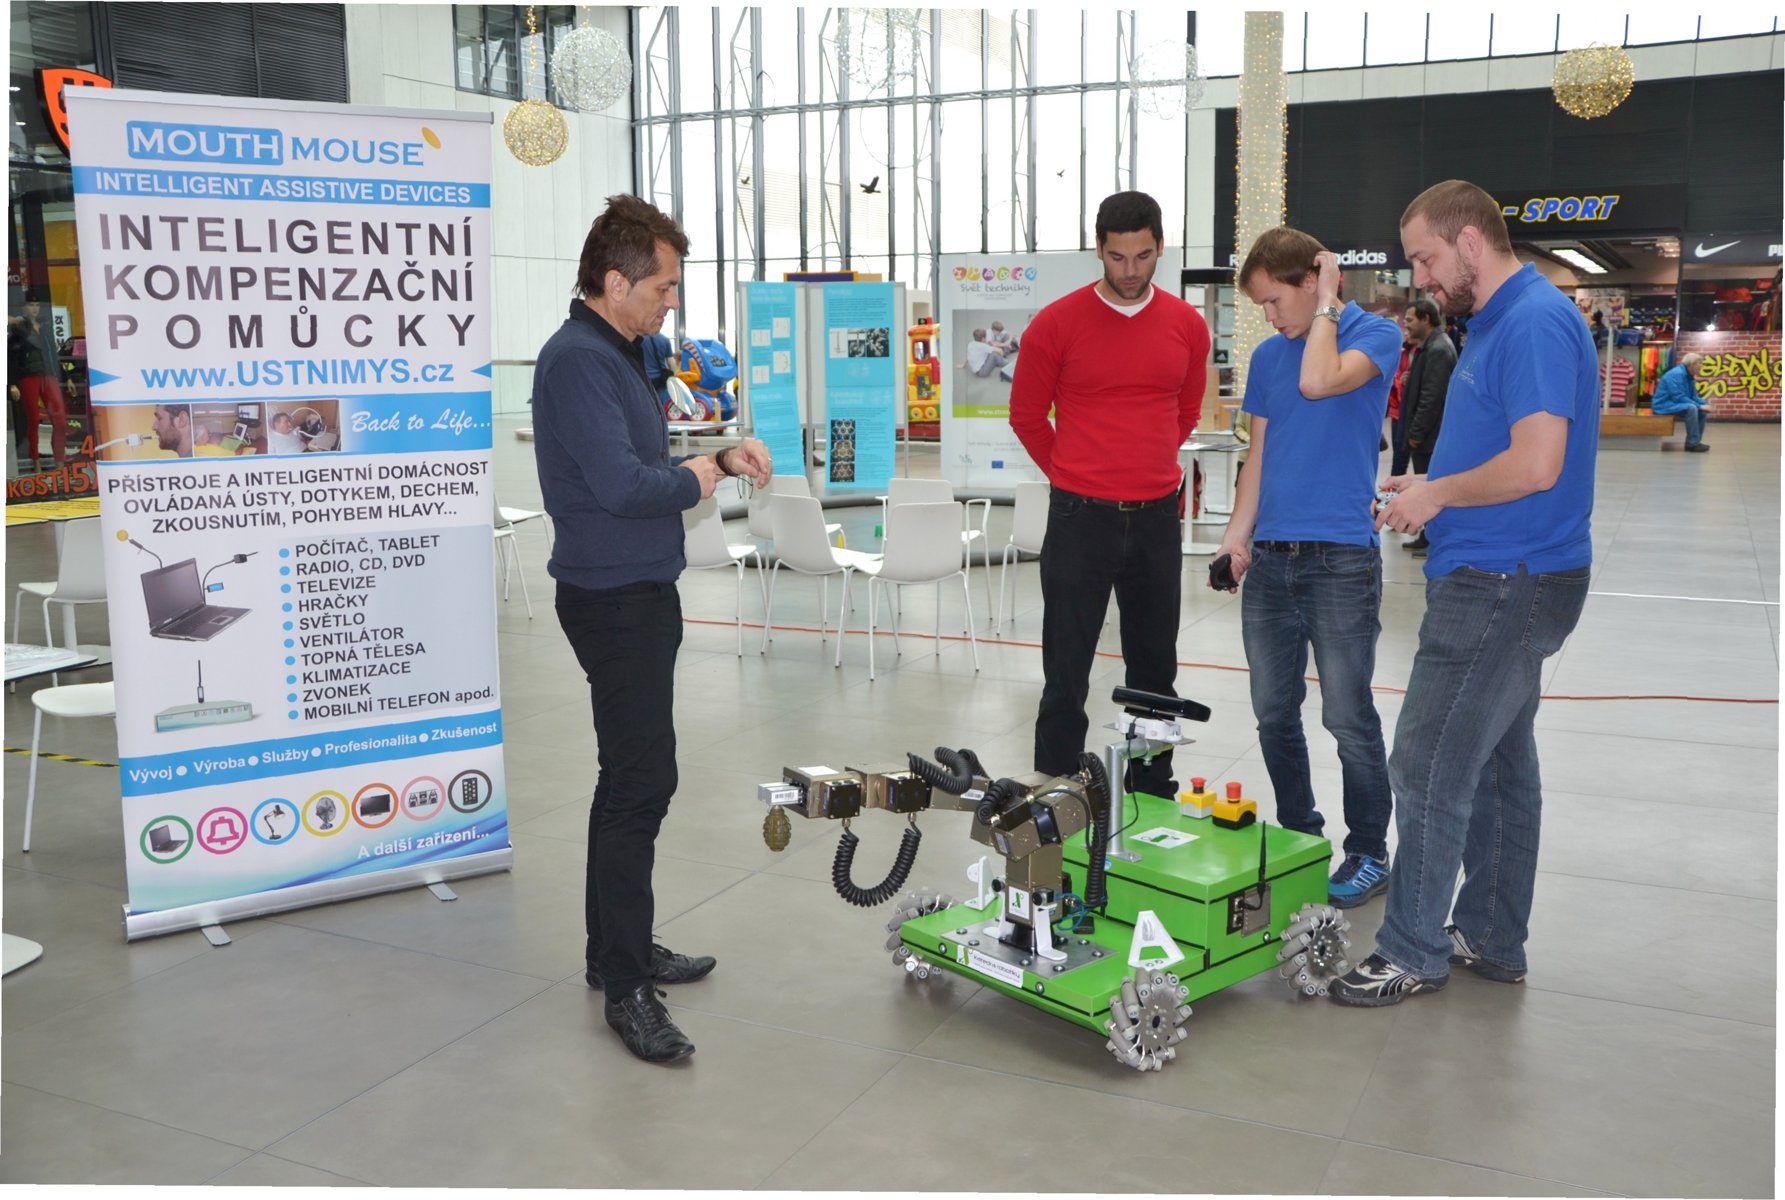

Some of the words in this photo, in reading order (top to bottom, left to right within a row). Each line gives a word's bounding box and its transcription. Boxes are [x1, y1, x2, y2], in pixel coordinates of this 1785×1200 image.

[132, 128, 280, 160] MOUTH
[292, 137, 424, 166] MOUSE
[96, 172, 255, 196] INTELLIGENT
[259, 179, 373, 199] ASSISTIVE
[380, 183, 470, 203] DEVICES
[1520, 195, 1620, 223] SPORT
[99, 213, 472, 257] INTELIGENTNÍ
[1336, 250, 1387, 265] adidas
[104, 260, 473, 301] KOMPENZAČNÍ
[960, 283, 980, 292] Svět
[985, 283, 1031, 296] techniky
[108, 305, 475, 350] POMŮCKY
[141, 358, 454, 389] www.USTNIMYS.cz
[351, 411, 400, 434] Back
[407, 413, 424, 430] to
[430, 409, 491, 435] Life...
[109, 472, 221, 493] PŘÍSTROJE
[226, 473, 240, 488] A
[245, 463, 372, 487] INTELIGENTNÍ
[379, 459, 488, 480] DOMÁCNOST
[124, 490, 235, 514] OVLÁDANÁ
[242, 487, 295, 508] ÚSTY,
[301, 484, 395, 503] DOTYKEM,
[400, 480, 479, 499] DECHEM,
[152, 508, 286, 534] ZKOUSNUTÍM,
[292, 504, 382, 525] POHYBEM
[388, 501, 457, 519] HLAVY...
[295, 537, 373, 557] POČÍTAČ,
[378, 535, 440, 551] TABLET
[296, 559, 354, 576] RADIO,
[359, 557, 387, 571] CD,
[393, 554, 425, 569] DVD
[297, 576, 376, 594] TELEVIZE
[298, 594, 368, 612] HRAČKY
[299, 612, 365, 631] SVĚTLO
[300, 627, 404, 649] VENTILÁTOR
[301, 647, 358, 666] TOPNÁ
[363, 642, 426, 659] TĚLESA
[303, 661, 411, 684] KLIMATIZACE
[303, 683, 371, 703] ZVONEK
[305, 699, 373, 720] MOBILNÍ
[377, 691, 450, 711] TELEFON
[455, 686, 494, 703] apod.
[129, 765, 172, 784] Vývoj
[193, 755, 246, 775] Výroba
[262, 747, 309, 767] Služby
[324, 733, 417, 755] Profesionalita
[431, 721, 497, 741] Zkušenost
[357, 846, 370, 859] A
[374, 838, 412, 857] další
[416, 826, 490, 848] zařízení...
